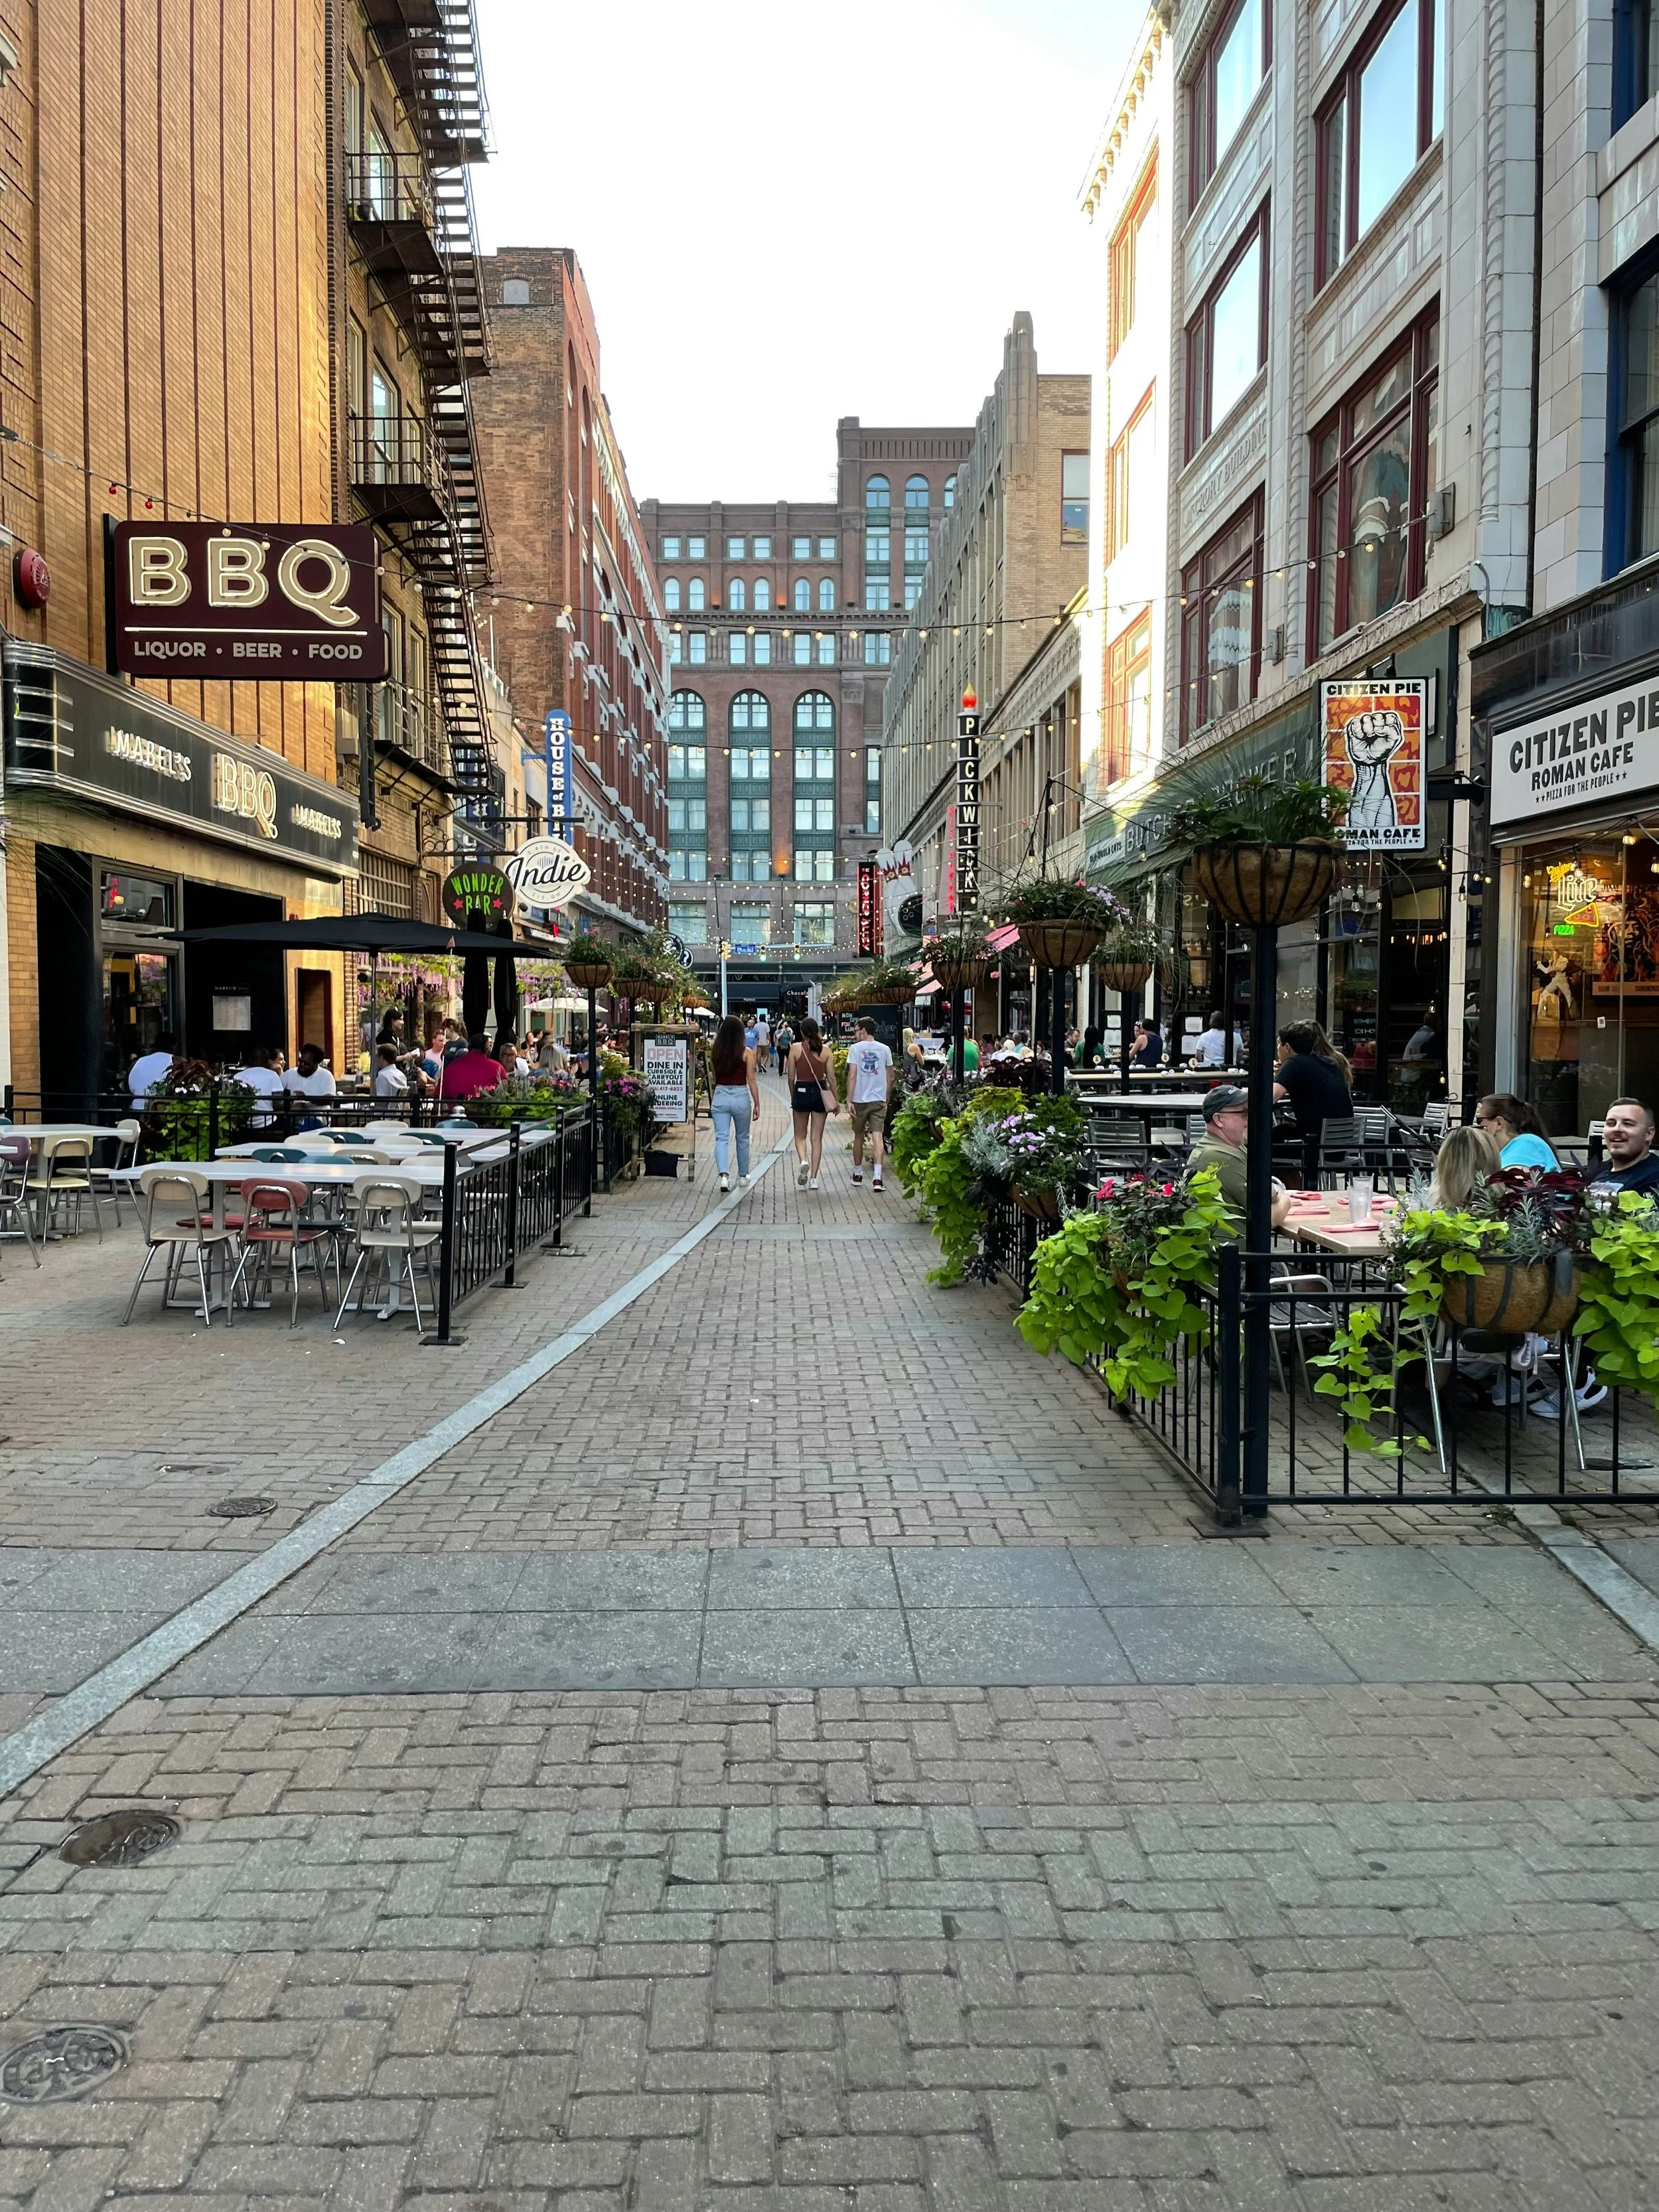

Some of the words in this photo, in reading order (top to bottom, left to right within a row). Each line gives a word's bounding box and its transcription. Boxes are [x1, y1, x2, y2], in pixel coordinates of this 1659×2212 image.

[129, 537, 360, 627] BBQ
[135, 641, 206, 659] LIQUOR
[233, 642, 282, 658] BEER
[309, 644, 362, 659] FOOD
[1327, 683, 1390, 696] CITIZEN
[1395, 683, 1421, 694] PIE
[1510, 709, 1607, 774] CITIZEN
[1617, 691, 1659, 740] PIE
[106, 725, 192, 782] MABEL'S
[550, 717, 565, 790] HOUSE
[1532, 757, 1586, 791] ROMAN
[1590, 741, 1634, 773] CAFE
[216, 753, 278, 839] BBQ
[963, 717, 975, 888] PICKWICK
[1546, 788, 1562, 802] PIZZA
[1564, 784, 1575, 796] FOR
[1577, 780, 1589, 792] THE
[1590, 773, 1614, 789] PEOPLE
[1383, 828, 1421, 838] CAFE
[451, 873, 504, 895] WONDER
[505, 854, 587, 890] Indie
[1555, 874, 1598, 912] Lite
[647, 1048, 684, 1061] OPEN
